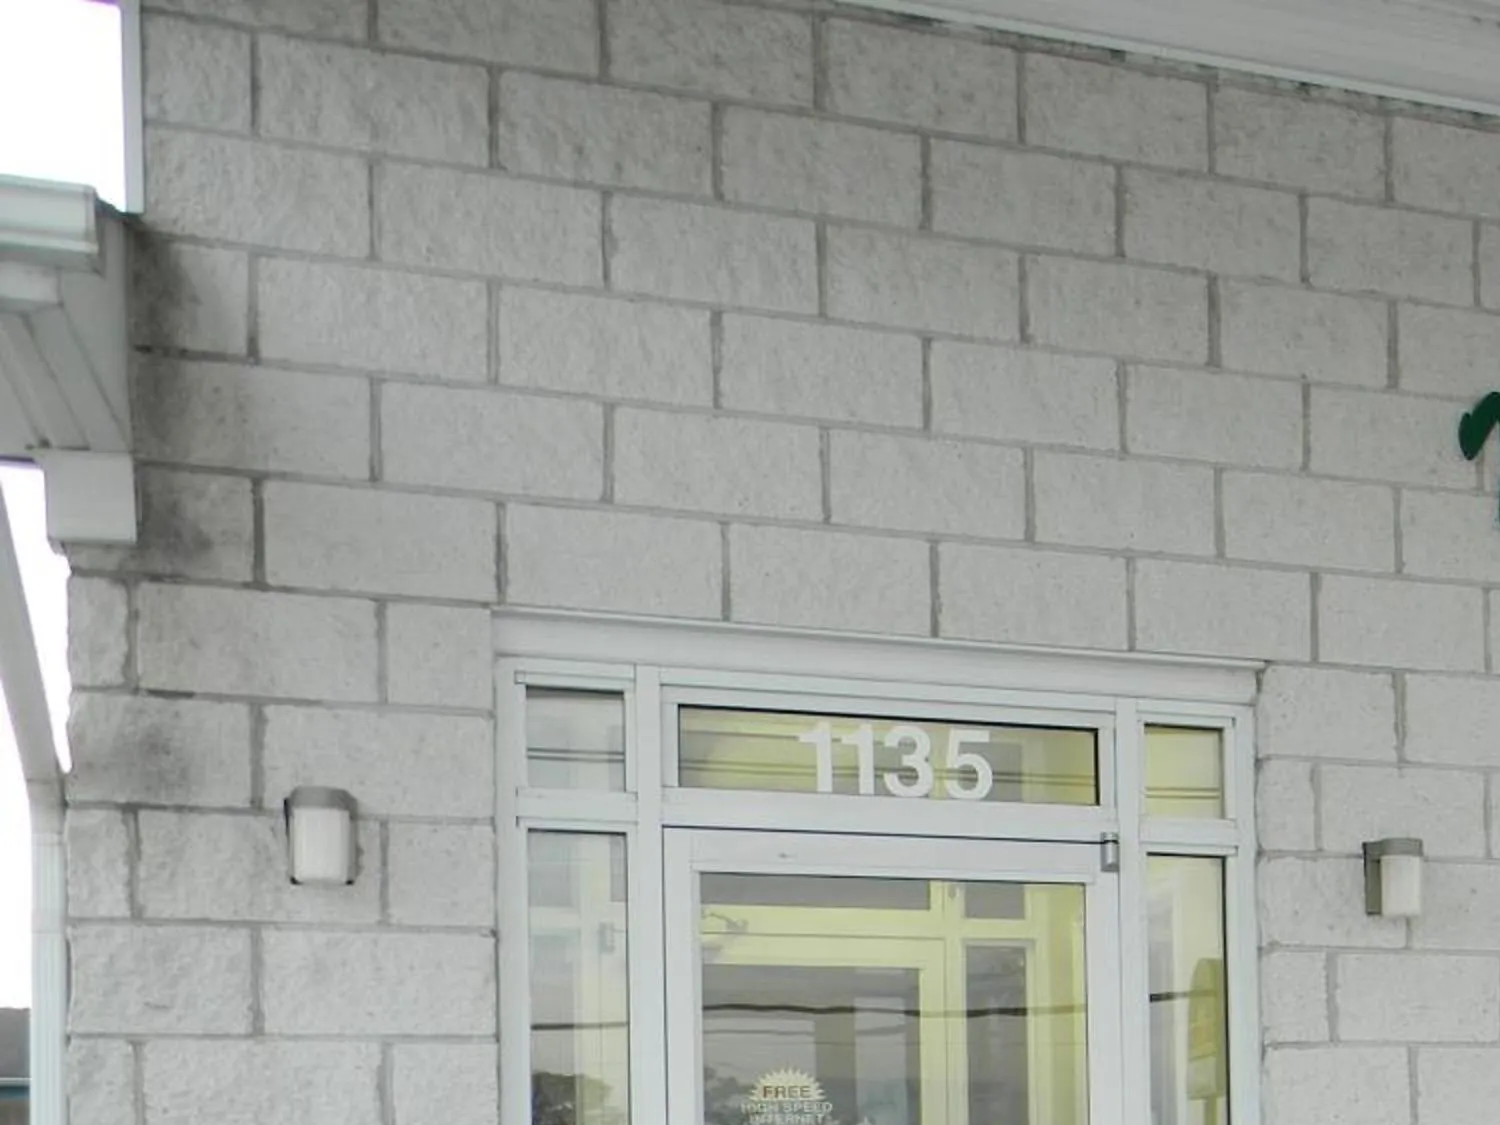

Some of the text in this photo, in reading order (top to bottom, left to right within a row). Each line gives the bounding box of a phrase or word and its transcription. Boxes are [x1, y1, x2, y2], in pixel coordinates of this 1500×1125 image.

[799, 721, 993, 800] 1135
[762, 1086, 811, 1098] FREE
[782, 1101, 833, 1114] SPEED
